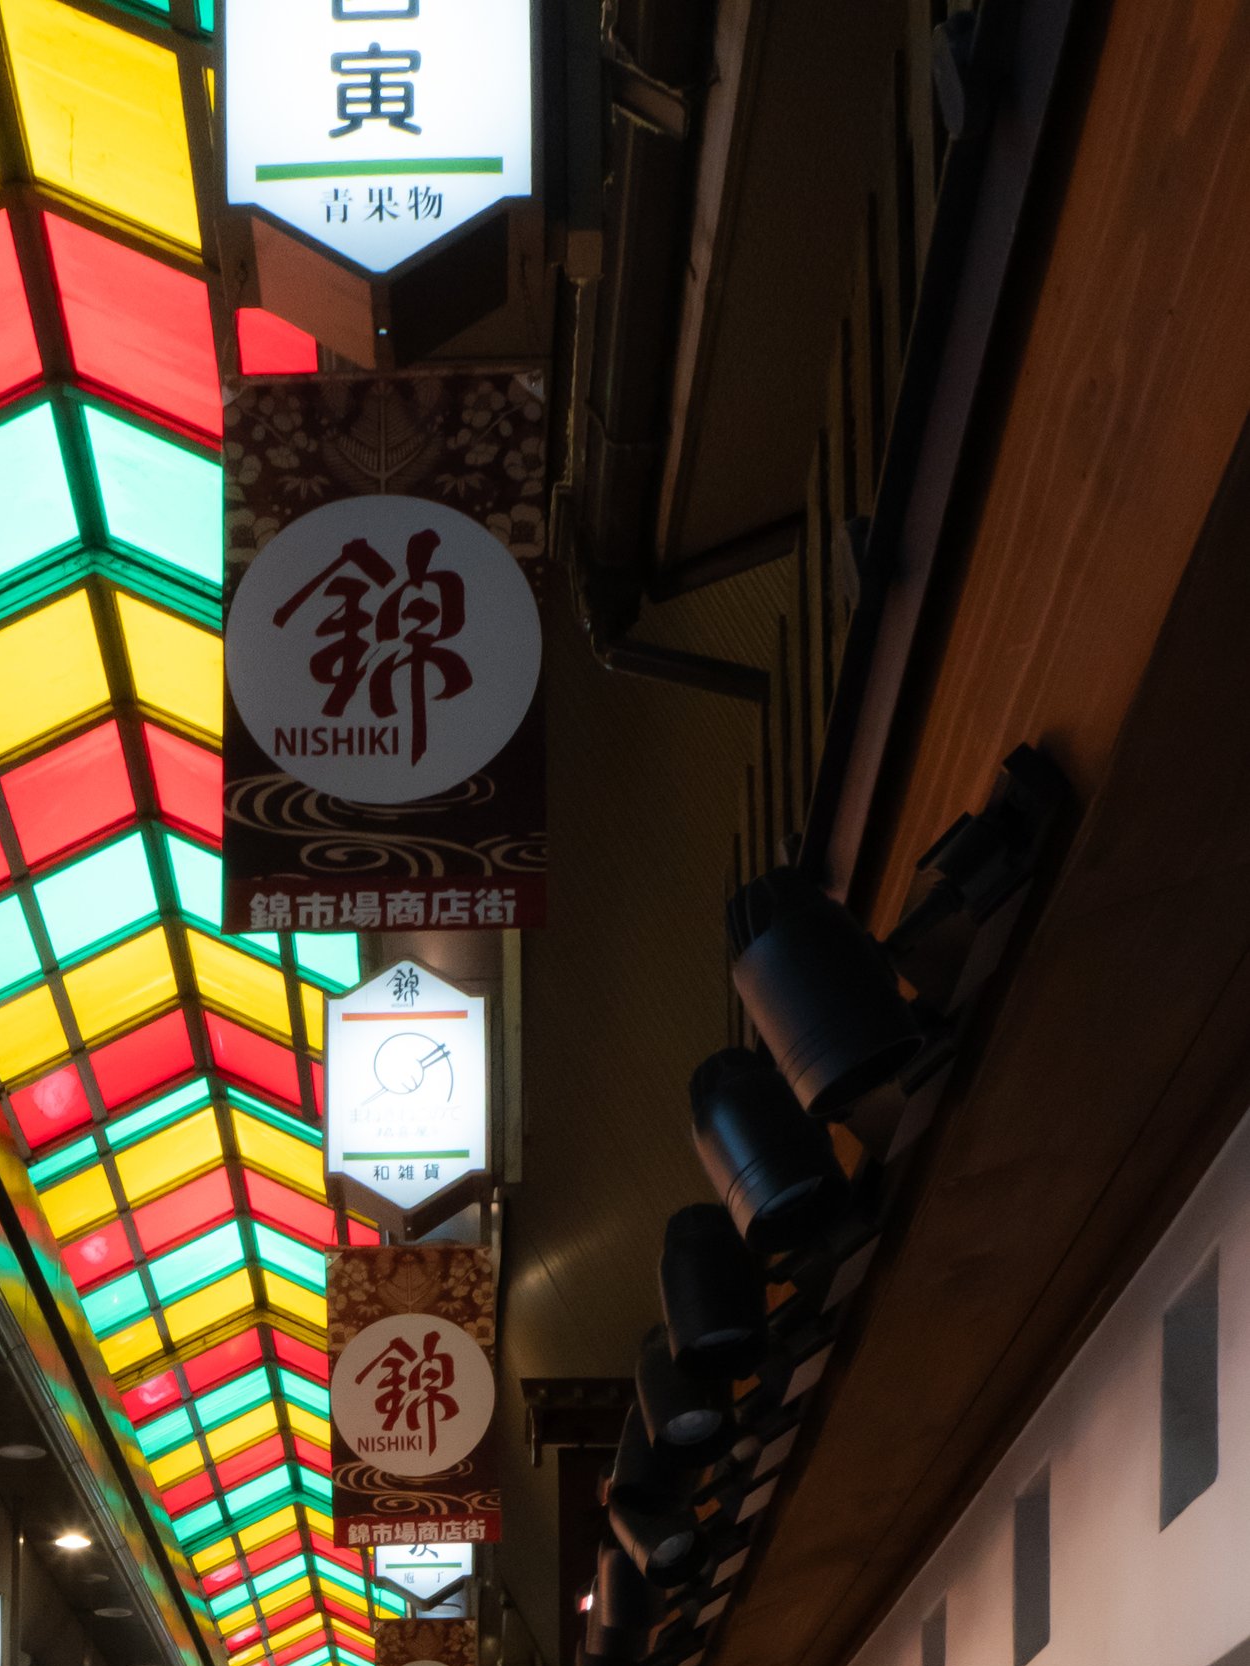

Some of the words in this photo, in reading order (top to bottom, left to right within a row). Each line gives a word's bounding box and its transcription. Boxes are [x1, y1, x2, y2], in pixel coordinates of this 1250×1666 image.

[328, 0, 423, 139] 寅
[320, 185, 444, 224] 青果物
[273, 529, 474, 767] 錦
[274, 726, 400, 757] NISHIKI
[250, 887, 516, 930] 錦市場商店街
[386, 967, 420, 1007] 錦
[373, 1163, 441, 1182] 和雑貨
[355, 1331, 460, 1457] 錦
[357, 1435, 423, 1453] NISHIKI
[348, 1519, 486, 1545] 錦市場商店街
